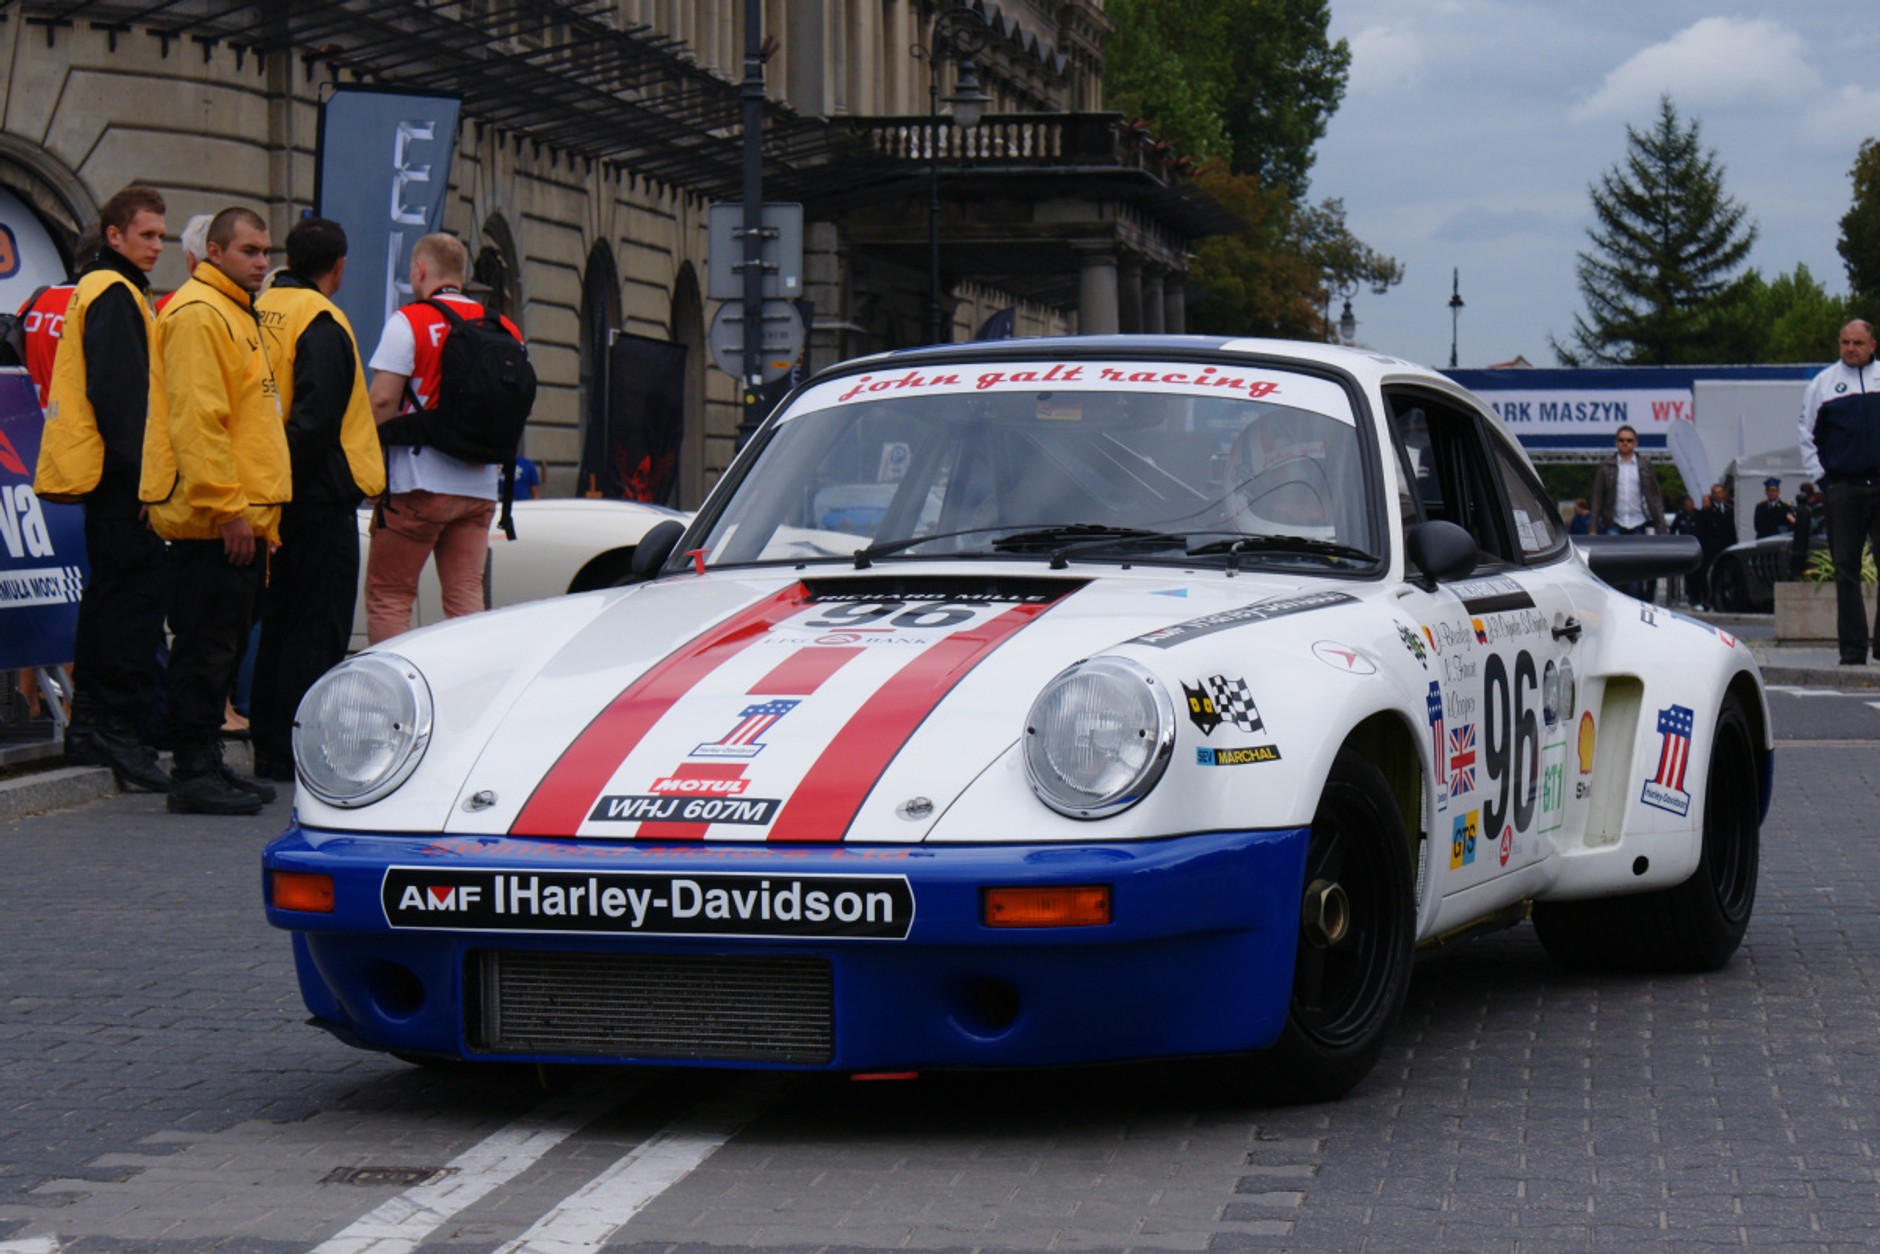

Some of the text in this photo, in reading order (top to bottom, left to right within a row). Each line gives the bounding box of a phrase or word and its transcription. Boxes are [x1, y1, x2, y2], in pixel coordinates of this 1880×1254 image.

[24, 310, 64, 337] OTO
[839, 364, 1282, 402] john galt racing
[1490, 401, 1695, 422] ARK MASZYN WYJ
[0, 577, 62, 601] MUŁA MOCY
[815, 593, 1046, 601] RICHARD MILLE
[804, 601, 991, 628] 96
[1217, 747, 1277, 763] MARCHAL
[1483, 649, 1538, 841] 96
[653, 779, 743, 793] MOTUL
[607, 798, 769, 822] WHJ 607M
[1454, 823, 1476, 859] GTS
[399, 885, 482, 912] AMF
